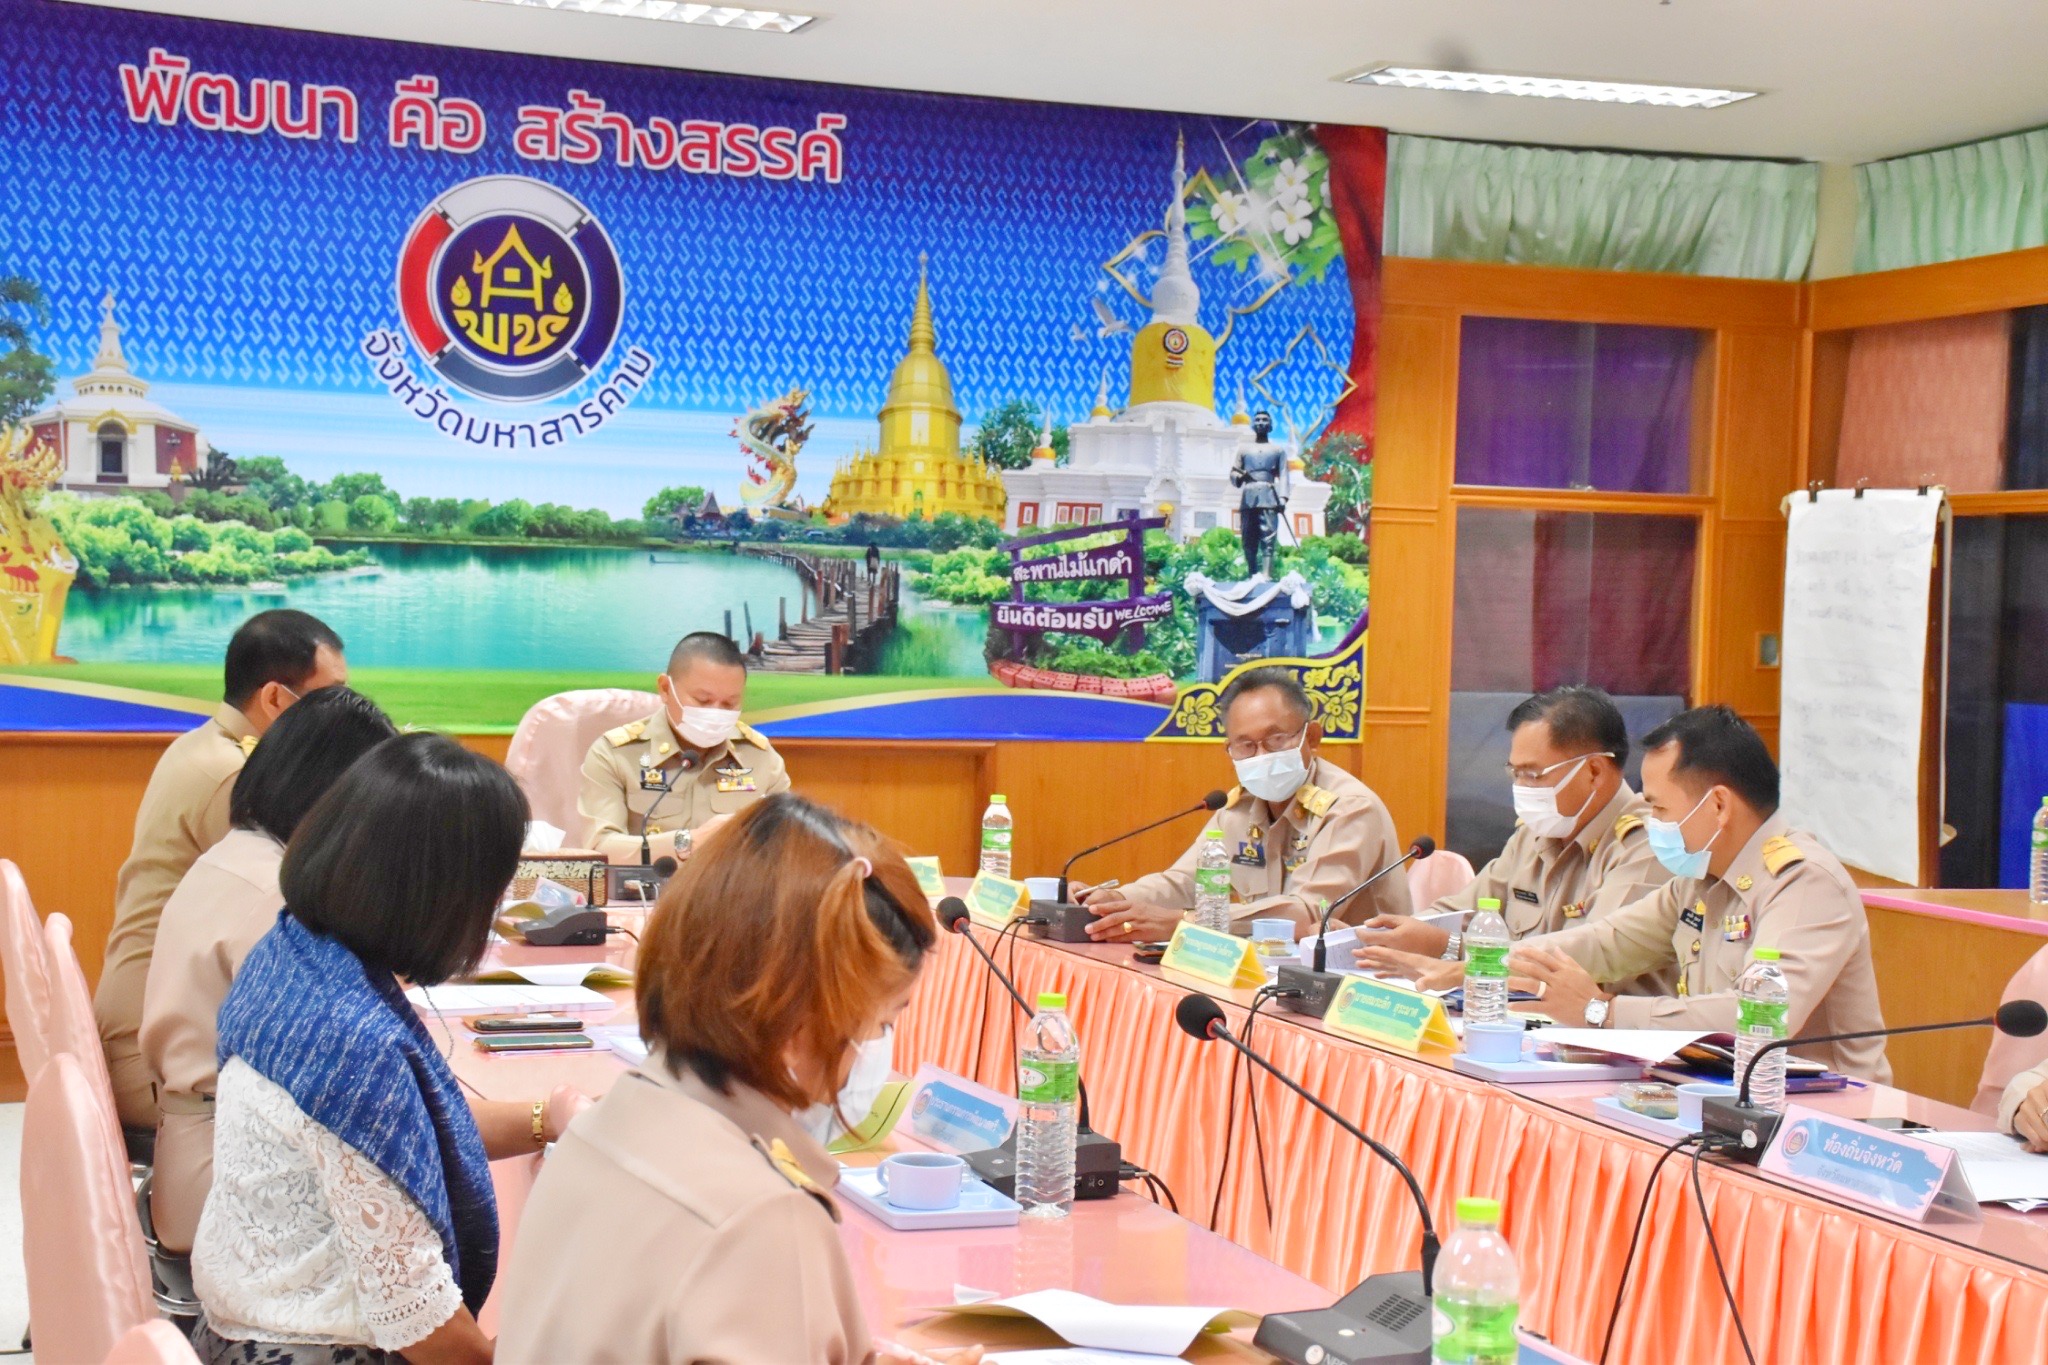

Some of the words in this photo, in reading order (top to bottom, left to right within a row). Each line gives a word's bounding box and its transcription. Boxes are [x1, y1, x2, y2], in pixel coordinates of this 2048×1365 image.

[119, 48, 358, 143] พัฒนา
[389, 75, 485, 153] คือ
[514, 91, 847, 184] สร้างสรรค์
[361, 328, 655, 450] จังหวัดมหาสารคาม
[1012, 550, 1133, 582] สะพานไม้แกดำ
[997, 605, 1113, 630] ยินดีต้อนรับ
[1114, 600, 1172, 621] WELCOME
[1822, 1132, 1903, 1174] ท้องถิ่นจังหวัด
